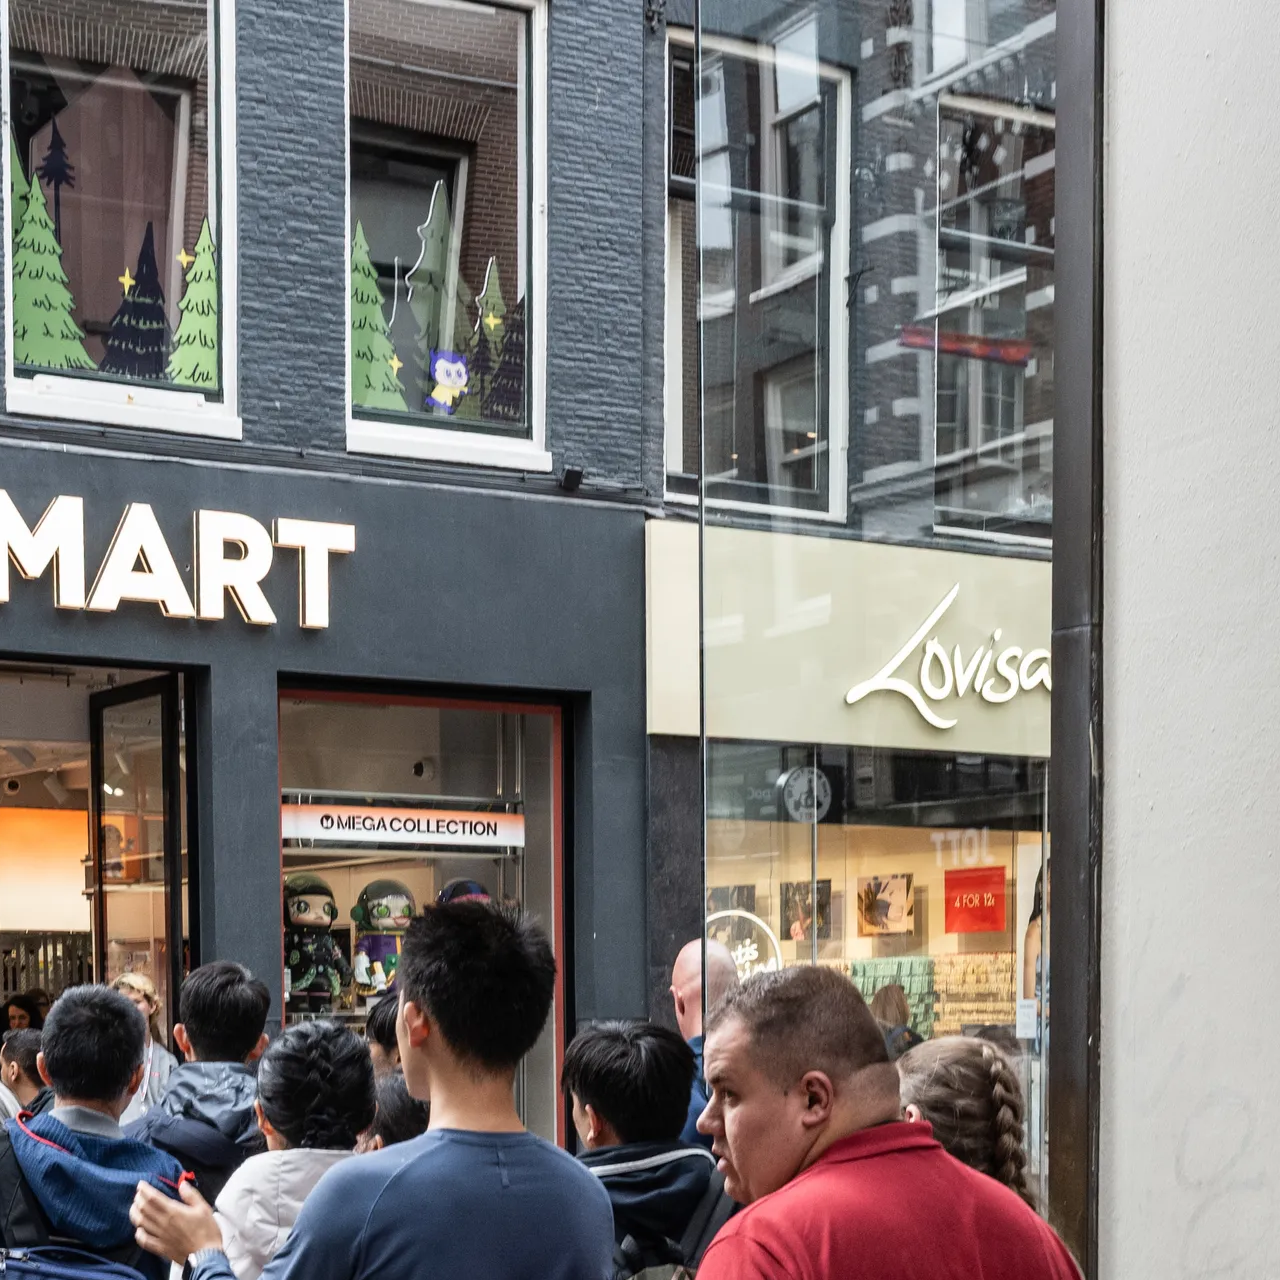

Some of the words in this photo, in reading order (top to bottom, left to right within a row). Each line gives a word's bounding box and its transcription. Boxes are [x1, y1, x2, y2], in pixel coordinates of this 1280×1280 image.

[845, 583, 1052, 730] Lovisa
[389, 817, 498, 837] COLLECTION
[954, 895, 960, 908] 4
[962, 893, 980, 908] FOR
